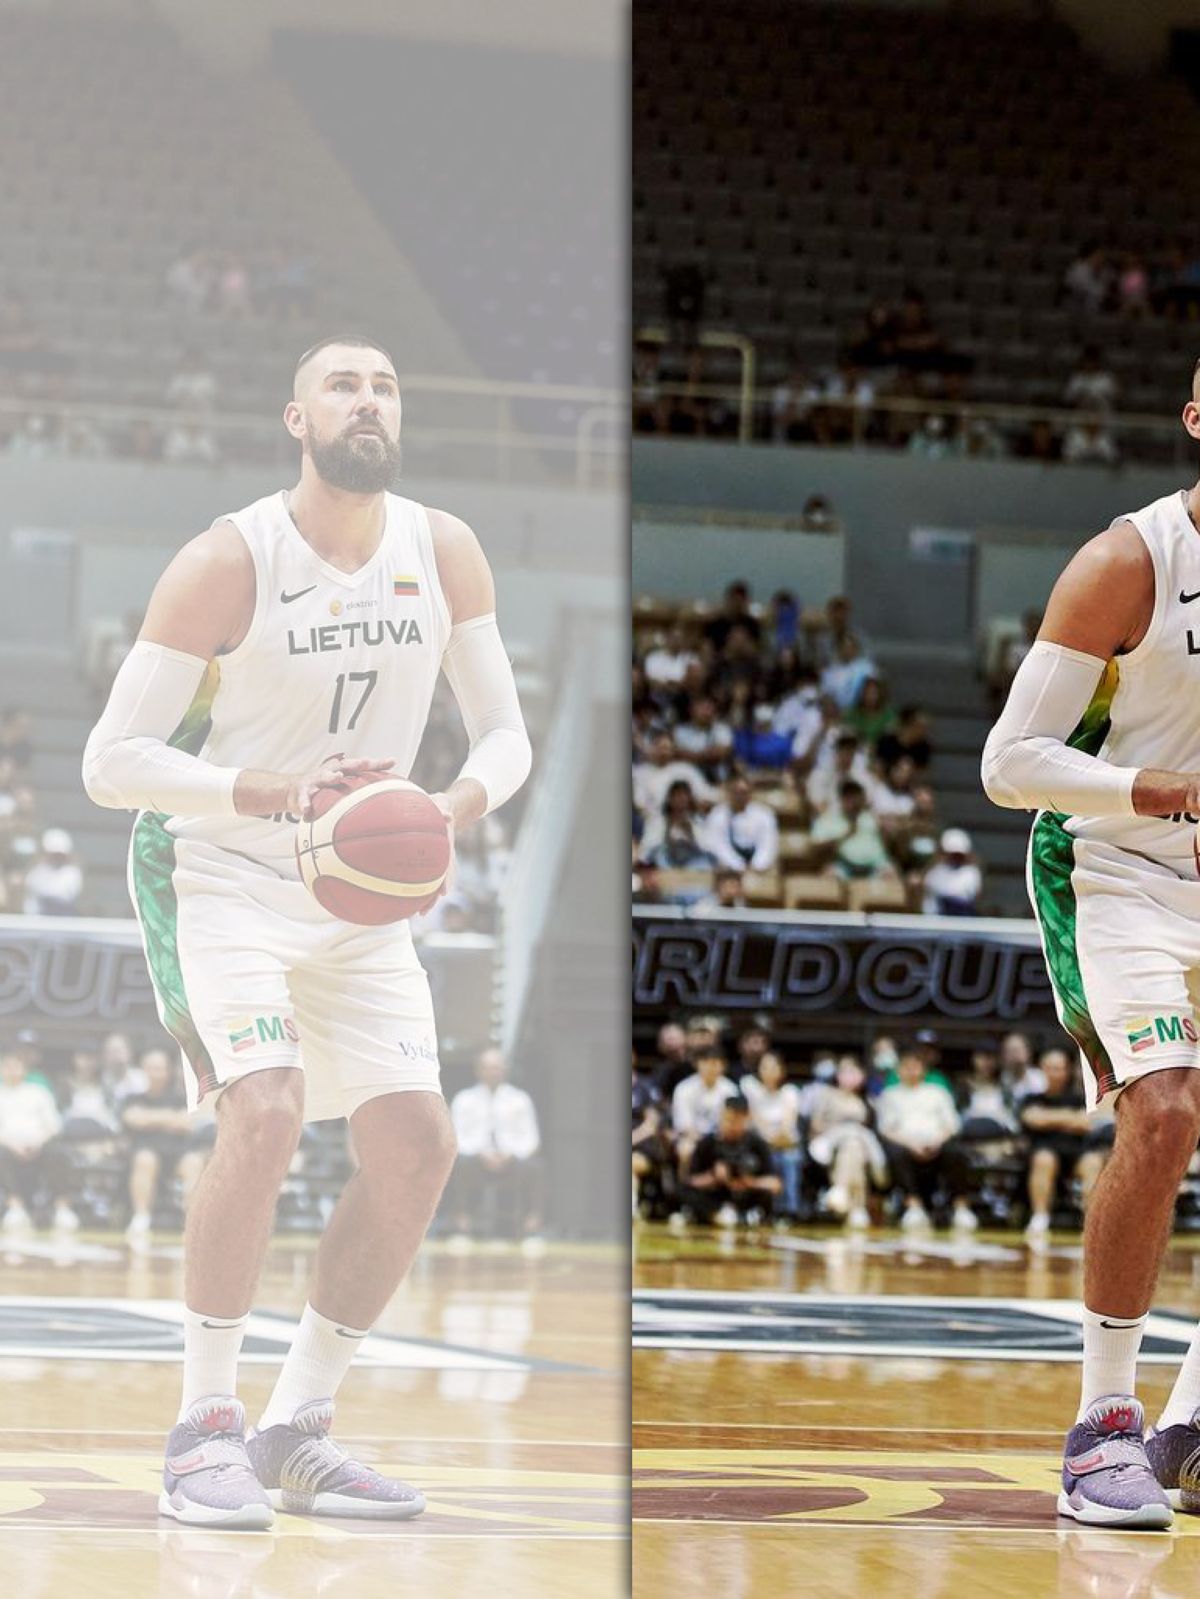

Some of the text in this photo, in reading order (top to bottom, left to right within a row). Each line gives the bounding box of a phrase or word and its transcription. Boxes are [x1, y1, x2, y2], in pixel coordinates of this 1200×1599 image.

[288, 619, 423, 655] LIETUVA
[328, 670, 378, 734] 17
[632, 923, 854, 1012] RLD
